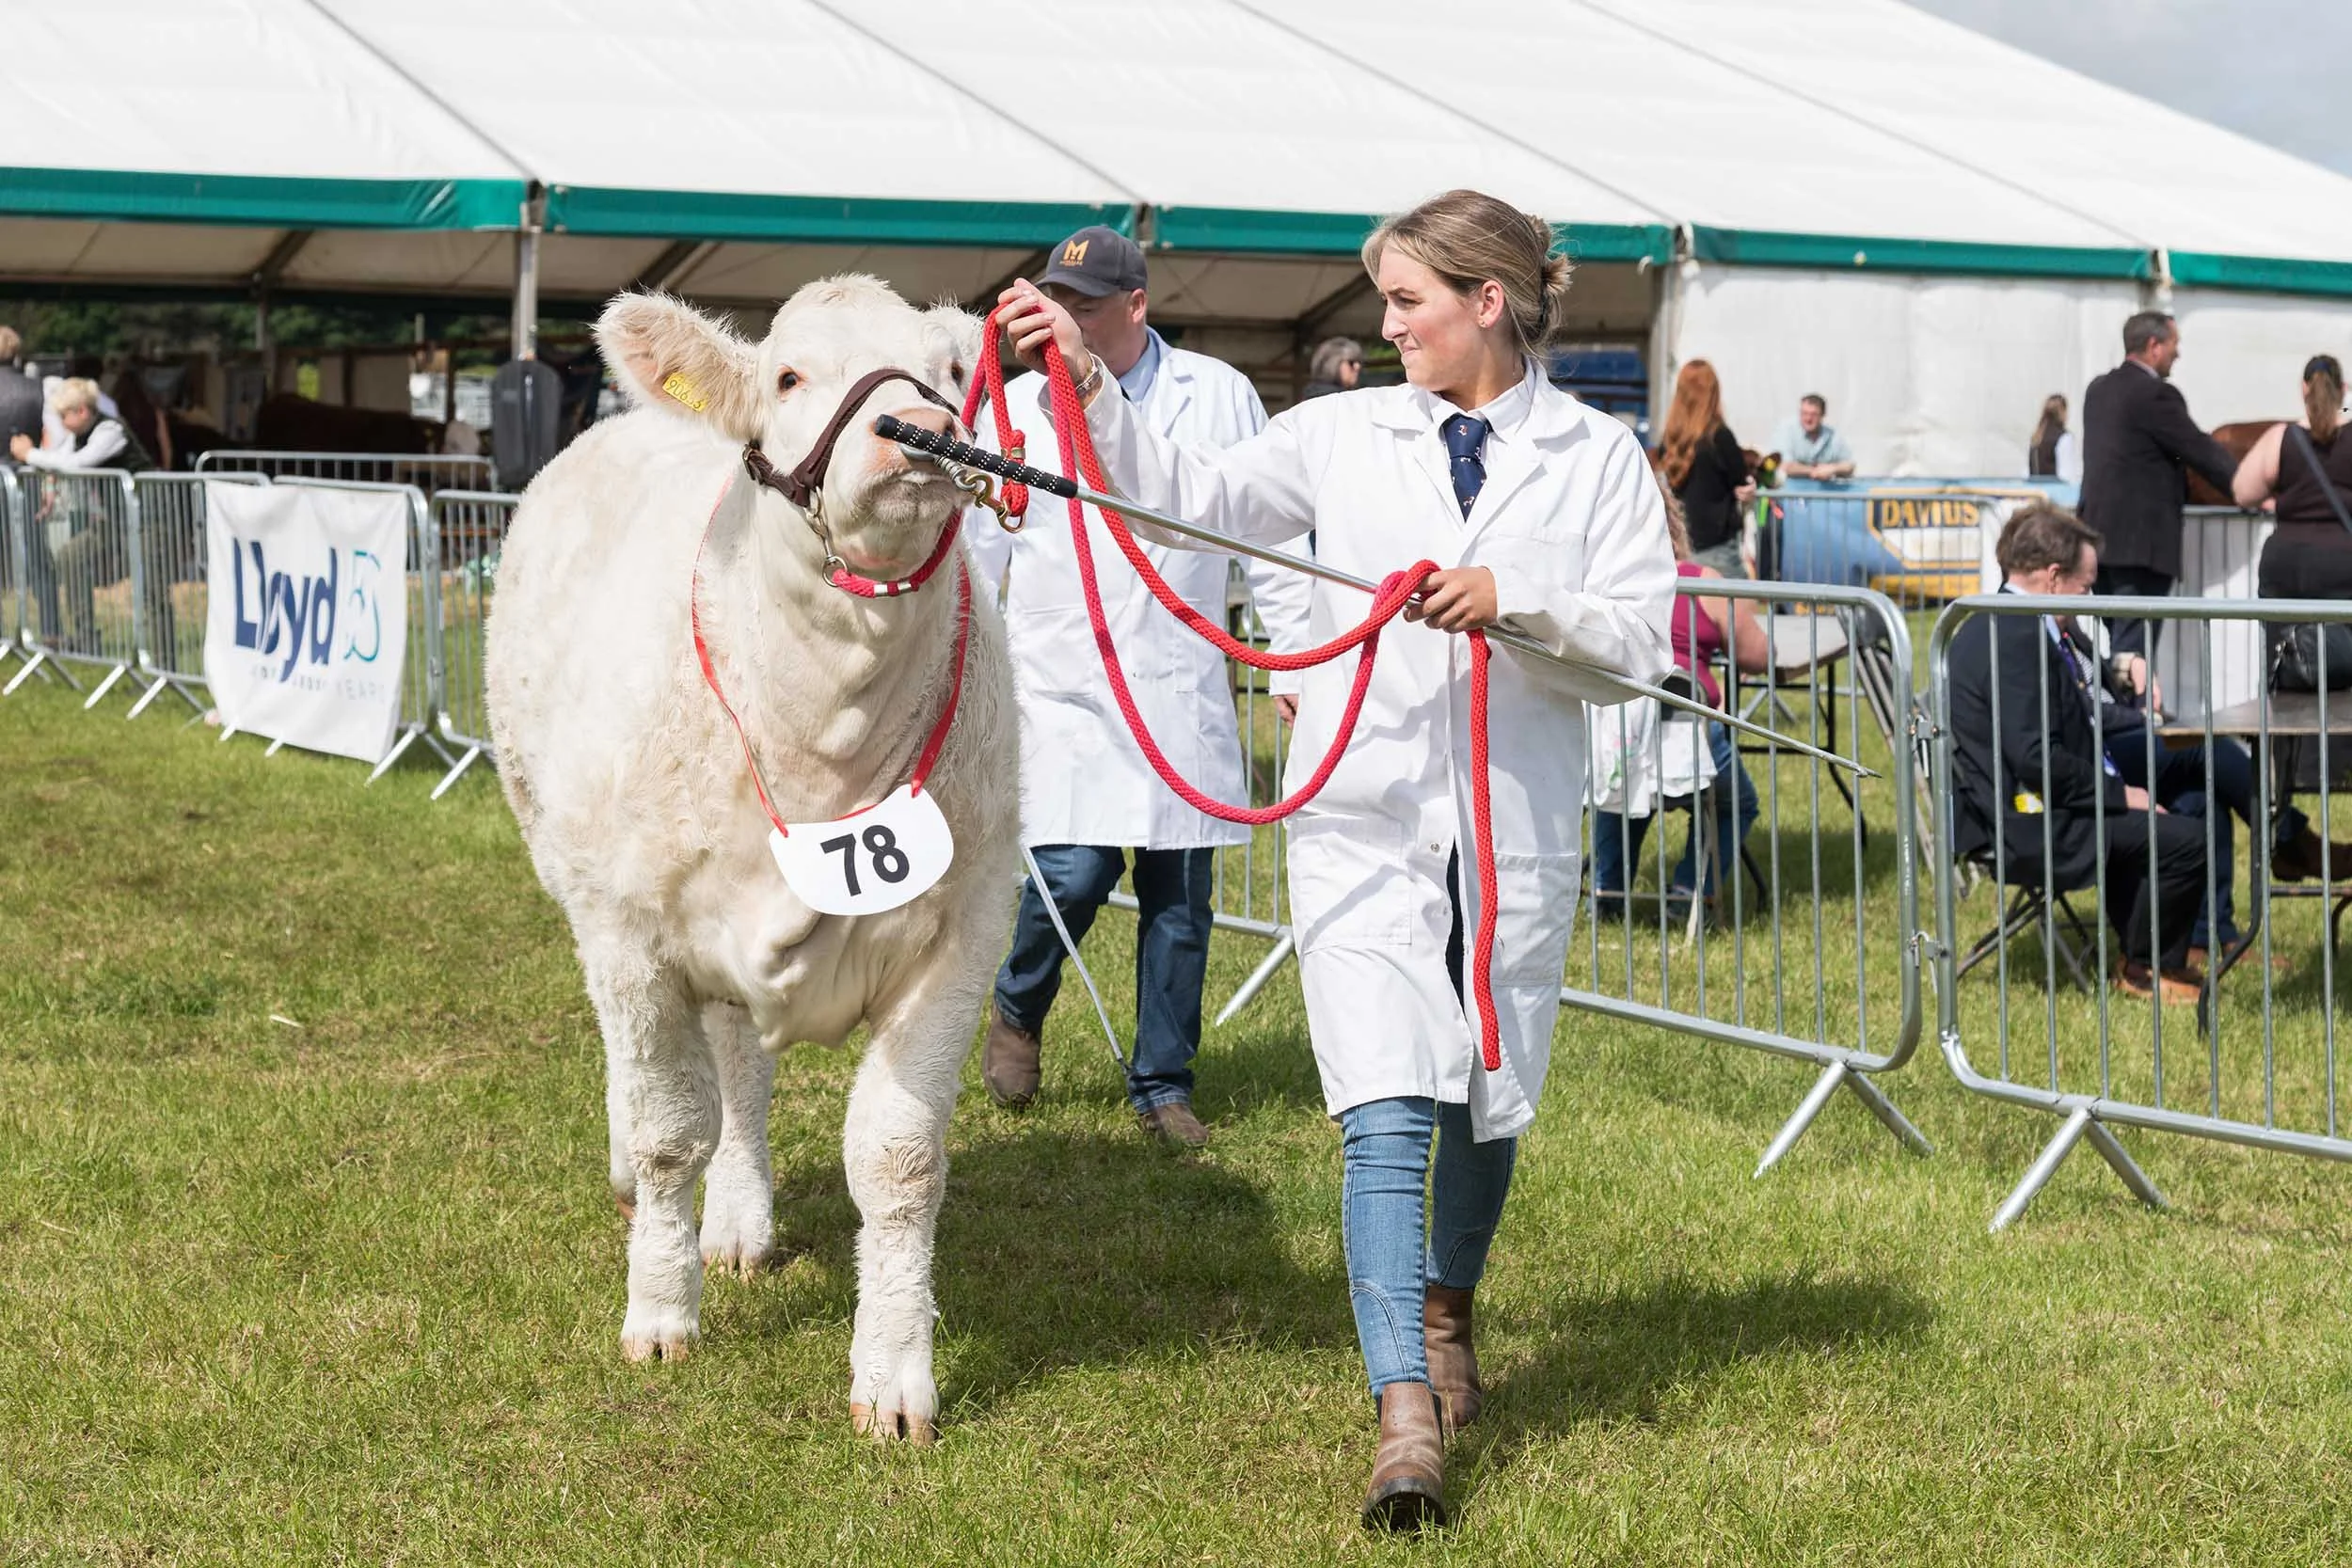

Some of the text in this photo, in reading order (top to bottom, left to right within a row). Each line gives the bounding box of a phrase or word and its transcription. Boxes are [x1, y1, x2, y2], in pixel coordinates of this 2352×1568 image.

[1062, 240, 1089, 261] M
[231, 537, 338, 683] Lloyd
[820, 825, 910, 896] 78
